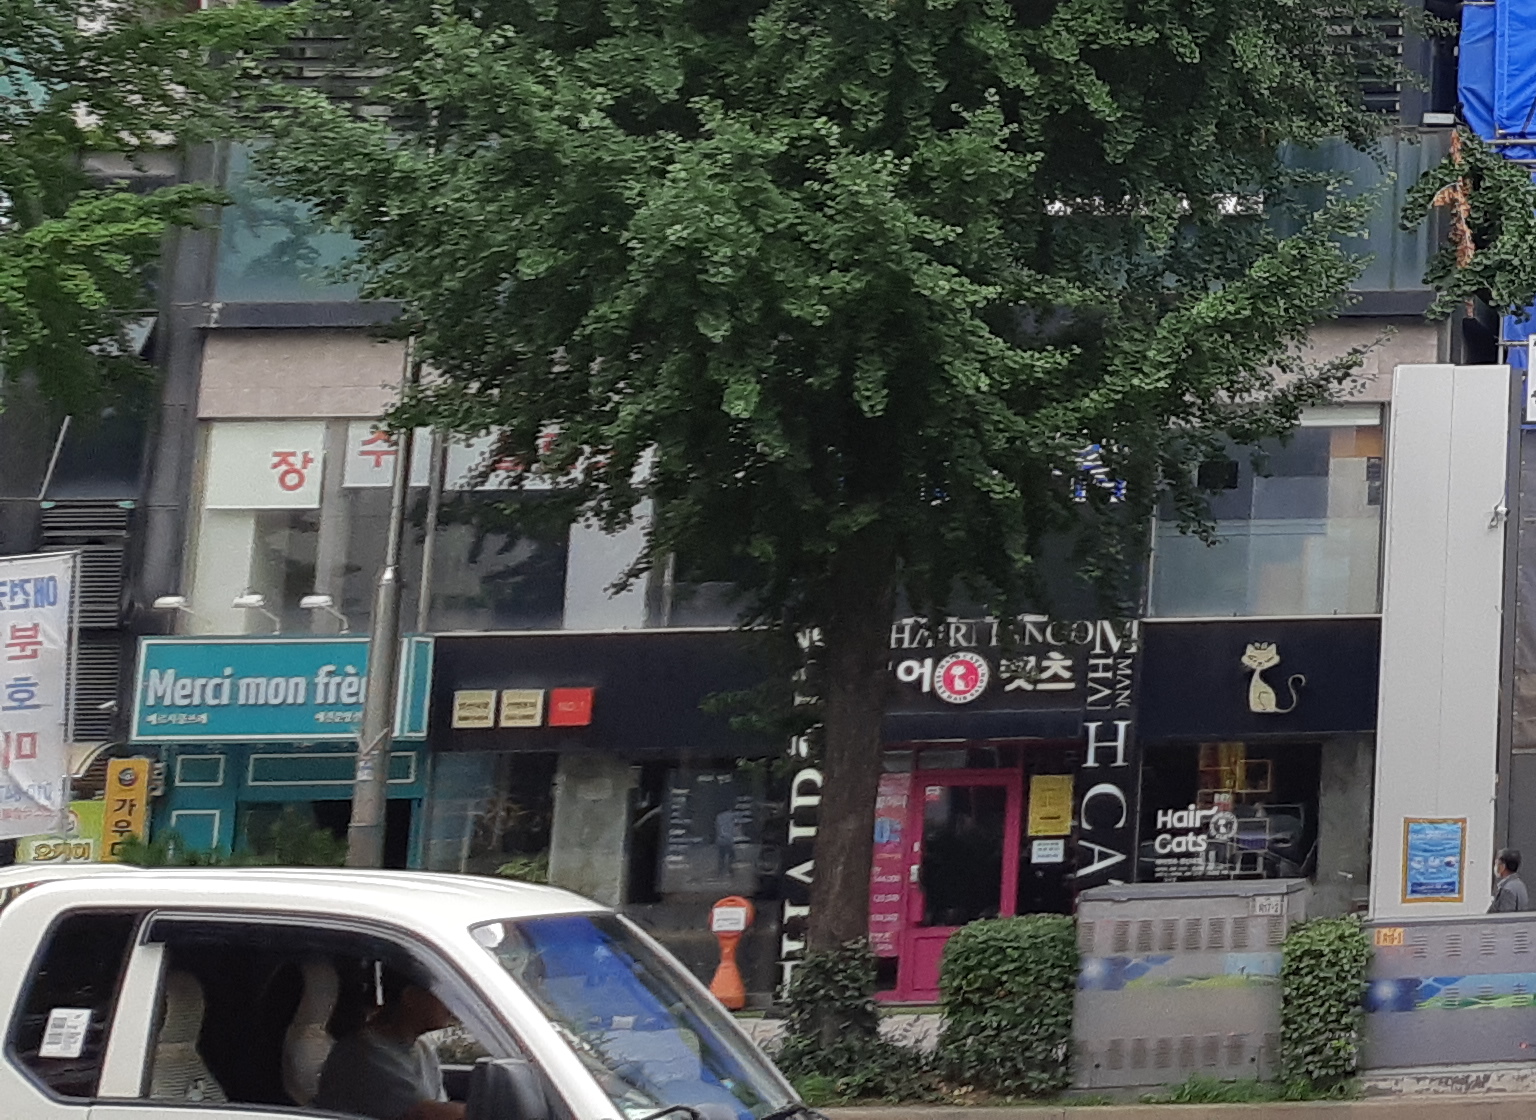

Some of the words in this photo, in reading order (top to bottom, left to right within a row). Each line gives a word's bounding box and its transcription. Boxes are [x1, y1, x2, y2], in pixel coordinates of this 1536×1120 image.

[146, 666, 232, 706] Merci
[237, 676, 307, 706] mon
[314, 665, 368, 705] frè
[888, 657, 932, 703] 어
[1156, 803, 1219, 829] Hair
[1154, 831, 1208, 854] Cats
